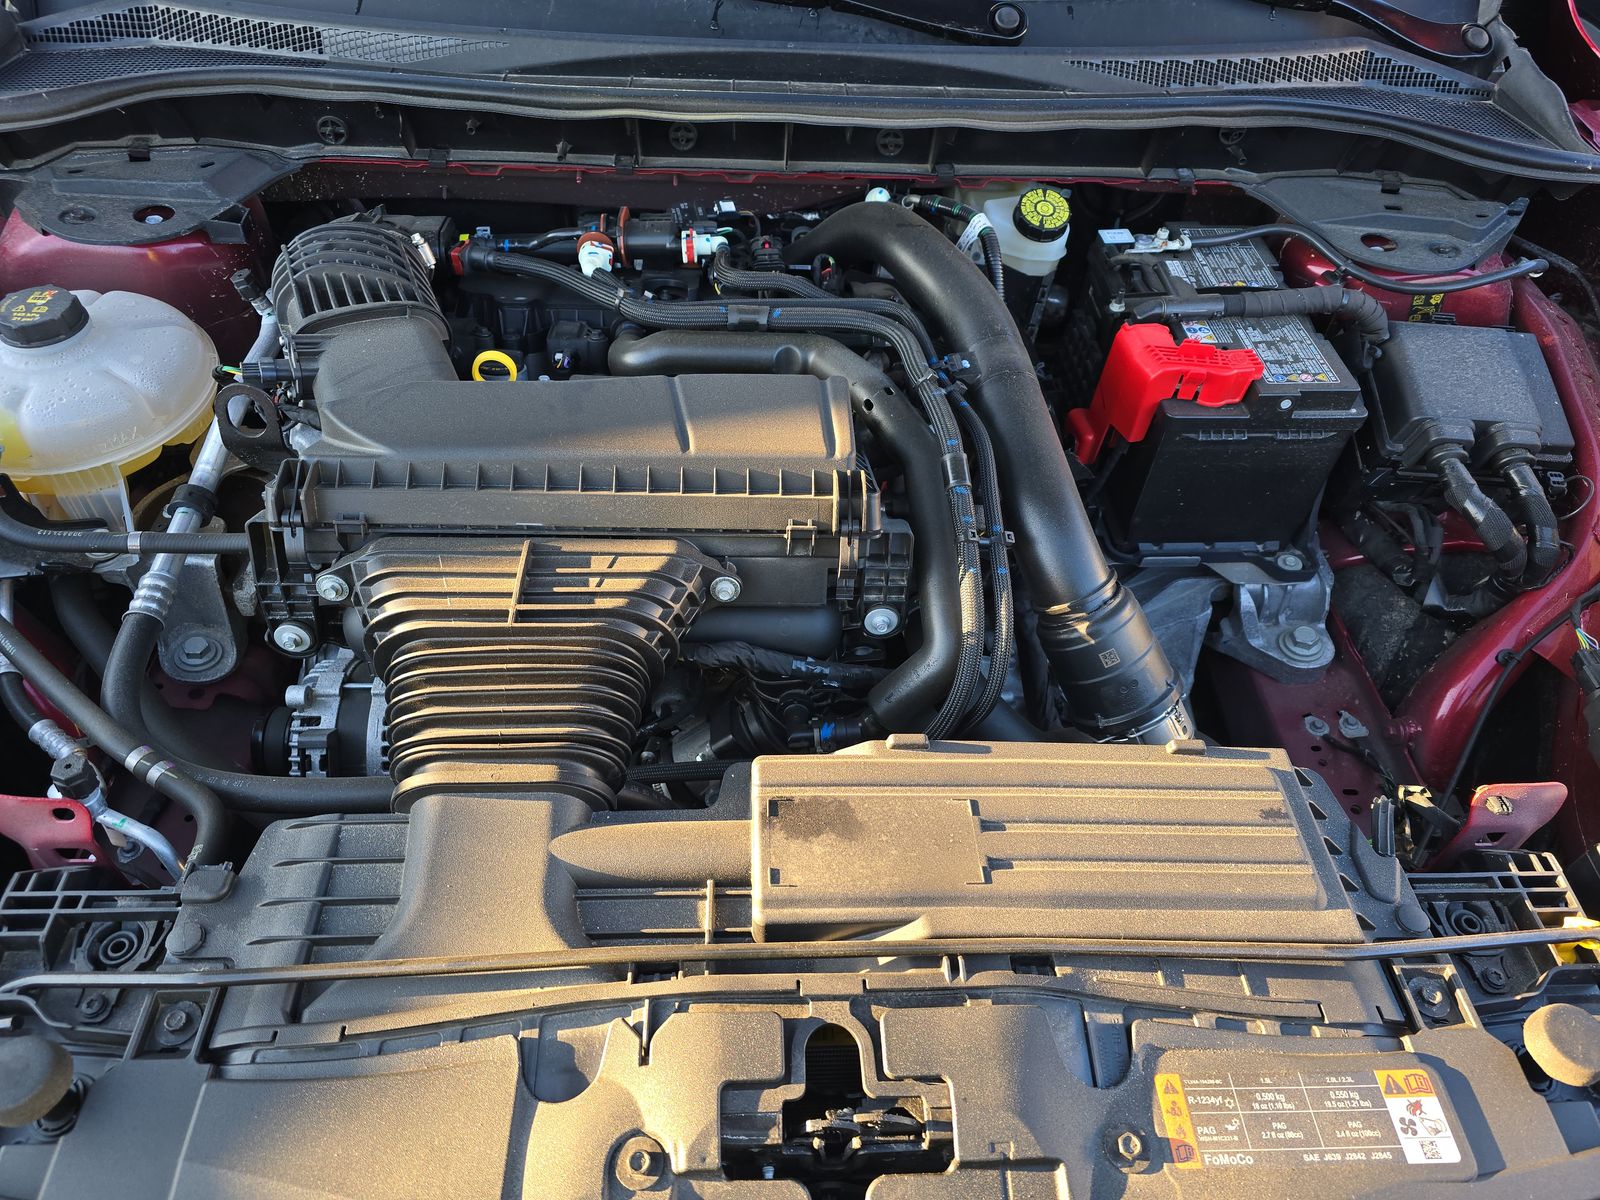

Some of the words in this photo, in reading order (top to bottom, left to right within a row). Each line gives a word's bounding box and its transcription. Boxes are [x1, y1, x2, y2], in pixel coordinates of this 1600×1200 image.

[1255, 1092, 1275, 1101] 0.500
[1275, 1092, 1286, 1102] kg
[1329, 1090, 1349, 1099] 0.550
[1349, 1090, 1360, 1100] kg
[1188, 1096, 1223, 1105] R-1234yf
[1197, 1126, 1216, 1135] PAG
[1272, 1122, 1287, 1130] PAG
[1204, 1153, 1254, 1165] FoMoCo
[1303, 1152, 1320, 1162] SAE
